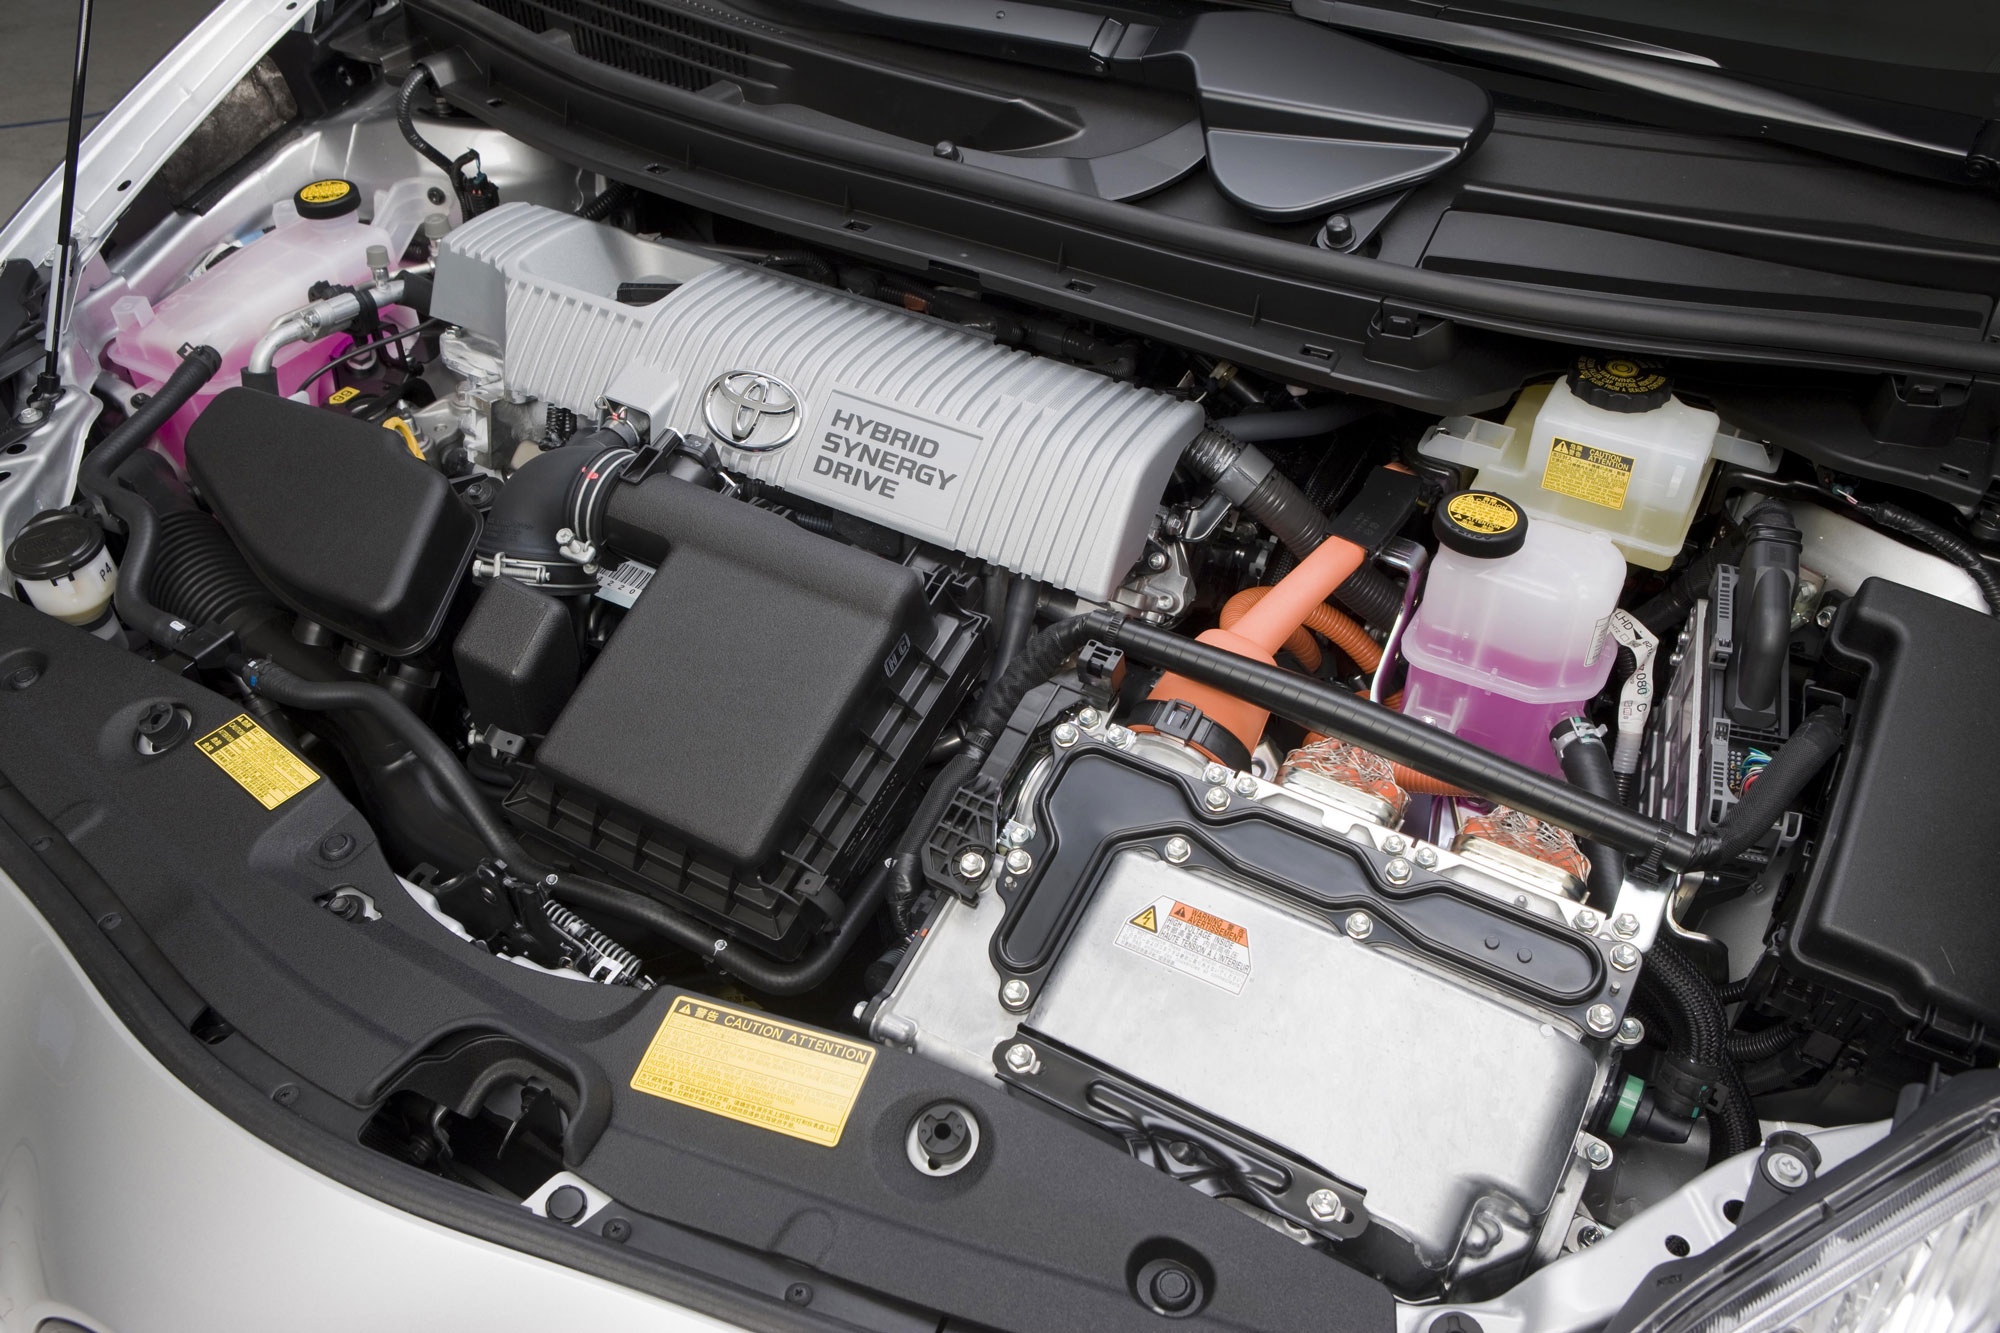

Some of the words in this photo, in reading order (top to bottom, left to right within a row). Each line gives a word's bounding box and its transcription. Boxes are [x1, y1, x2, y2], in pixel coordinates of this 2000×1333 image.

[831, 409, 940, 459] HYBRID
[821, 432, 958, 491] SYNERGY
[1587, 455, 1629, 471] ATTENTION
[1589, 448, 1622, 463] CAUTION
[813, 454, 900, 500] DRIVE
[99, 562, 113, 582] P4
[1614, 611, 1634, 631] LHD
[1191, 907, 1224, 927] WARNING
[1160, 931, 1181, 944] HAUTE
[1182, 938, 1205, 955] TENSION
[1167, 917, 1182, 928] HIGH
[1185, 922, 1212, 941] VOLTAGE
[1214, 935, 1234, 950] INSIDE
[1187, 917, 1244, 944] AVERTISSEMENT
[724, 1015, 784, 1040] CAUTION
[786, 1032, 868, 1064] ATTENTION
